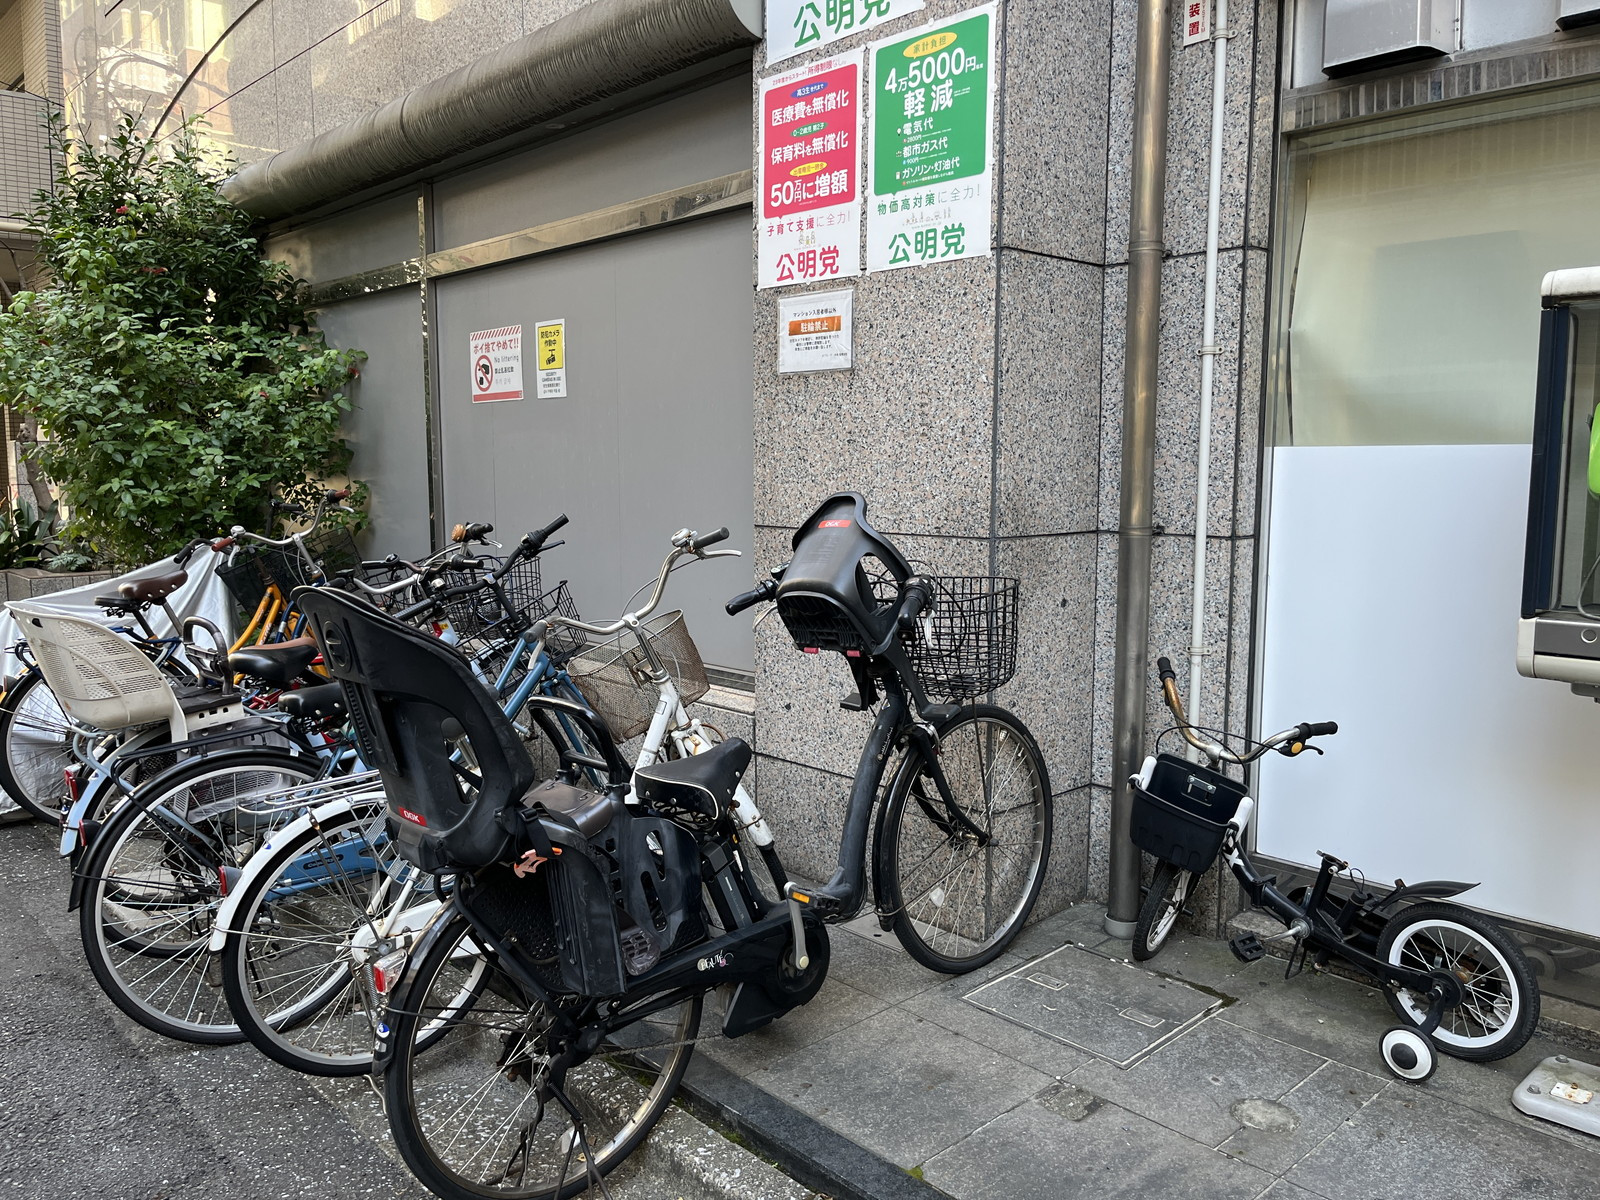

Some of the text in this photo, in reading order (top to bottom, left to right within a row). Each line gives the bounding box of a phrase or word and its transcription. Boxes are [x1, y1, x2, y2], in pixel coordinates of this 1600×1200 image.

[1188, 3, 1201, 37] 装置
[771, 89, 849, 126] 医療費を無償化
[903, 78, 953, 119] 軽減
[902, 117, 933, 136] 電気代
[771, 130, 849, 165] 保育料を無償化
[902, 136, 948, 158] 都市ガス代
[770, 168, 848, 207] 50万円に増額
[888, 222, 966, 265] 公明党
[776, 245, 839, 282] 公明党
[800, 320, 829, 333] 駐輪禁止
